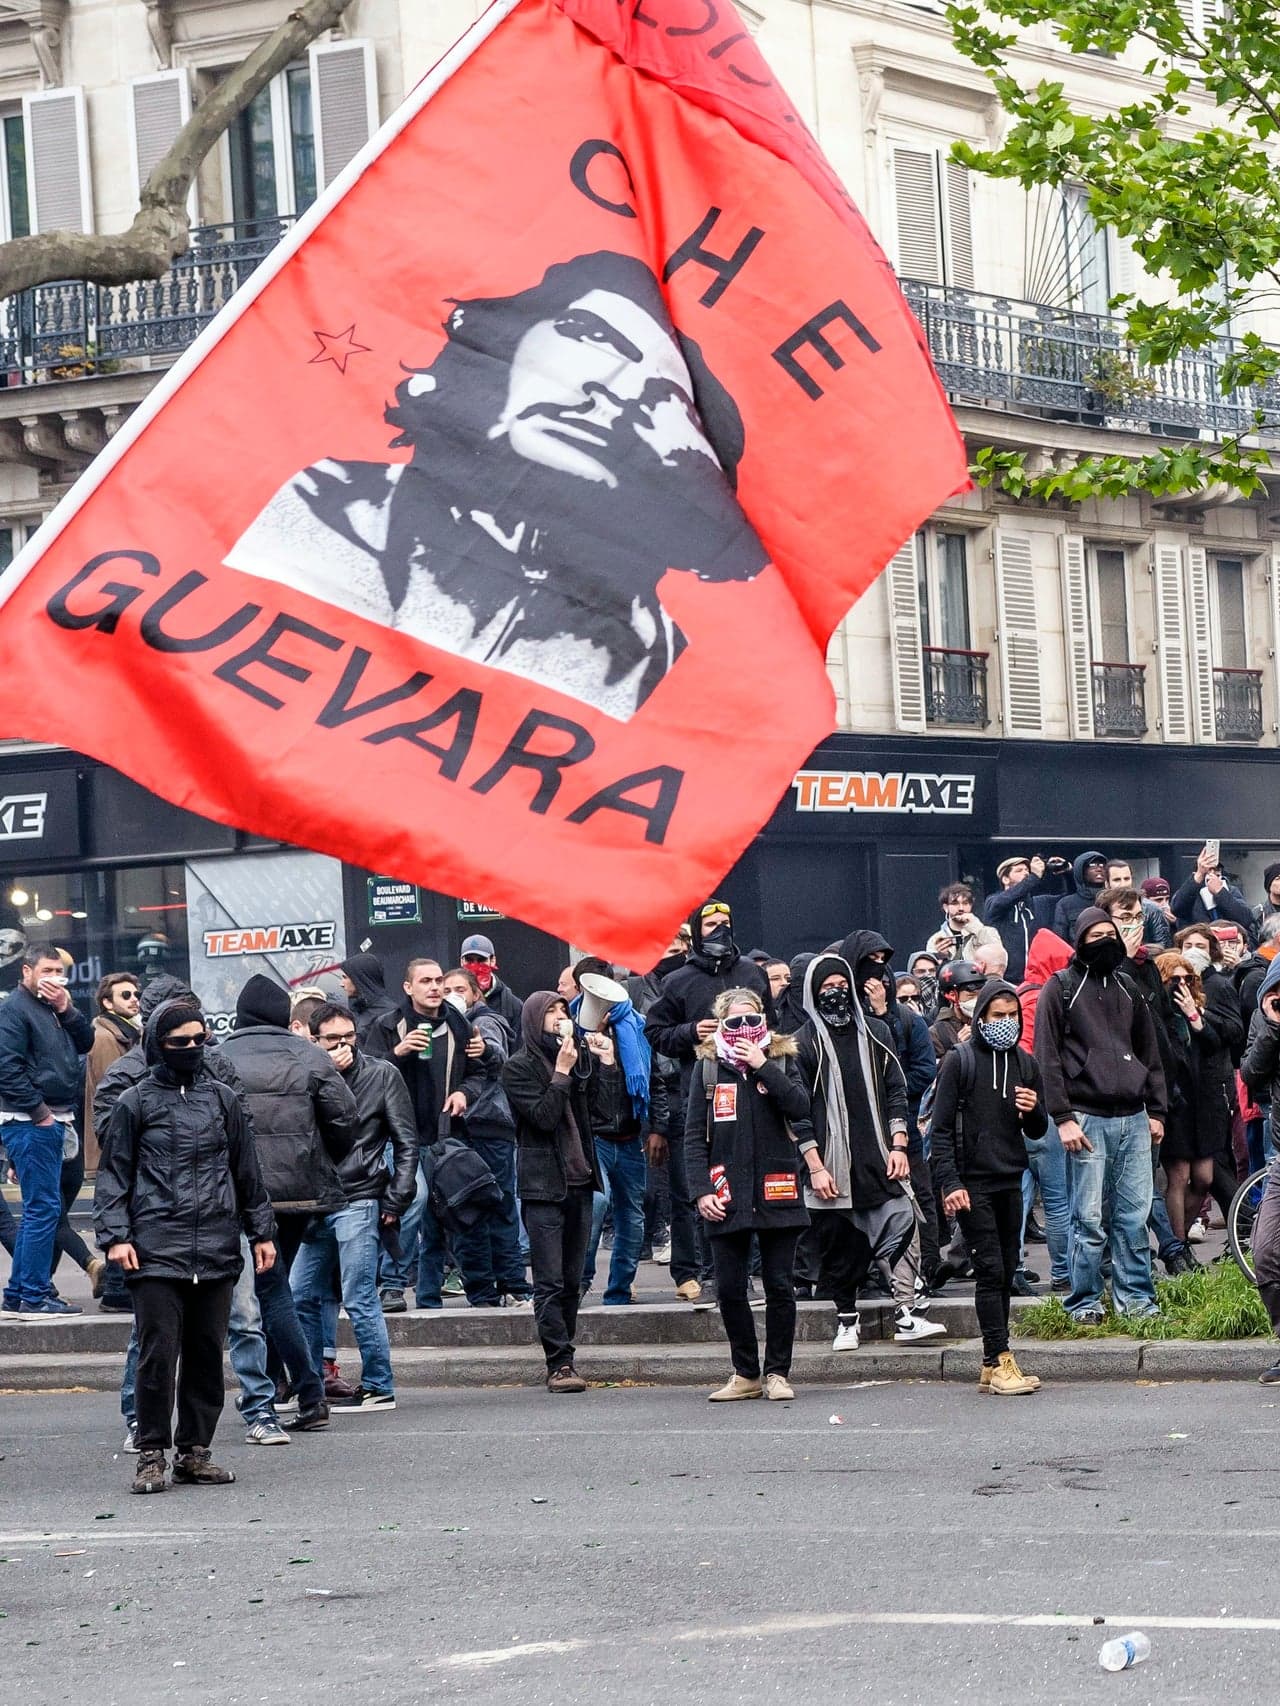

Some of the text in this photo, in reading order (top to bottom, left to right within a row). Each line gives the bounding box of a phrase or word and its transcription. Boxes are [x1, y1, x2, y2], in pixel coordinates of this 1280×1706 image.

[570, 139, 882, 401] CHE
[46, 550, 685, 845] GUEVARA
[0, 796, 46, 838] XE
[373, 895, 415, 905] BEAUMARCHAIS
[376, 885, 410, 895] BOULEVARD
[463, 902, 475, 912] DE
